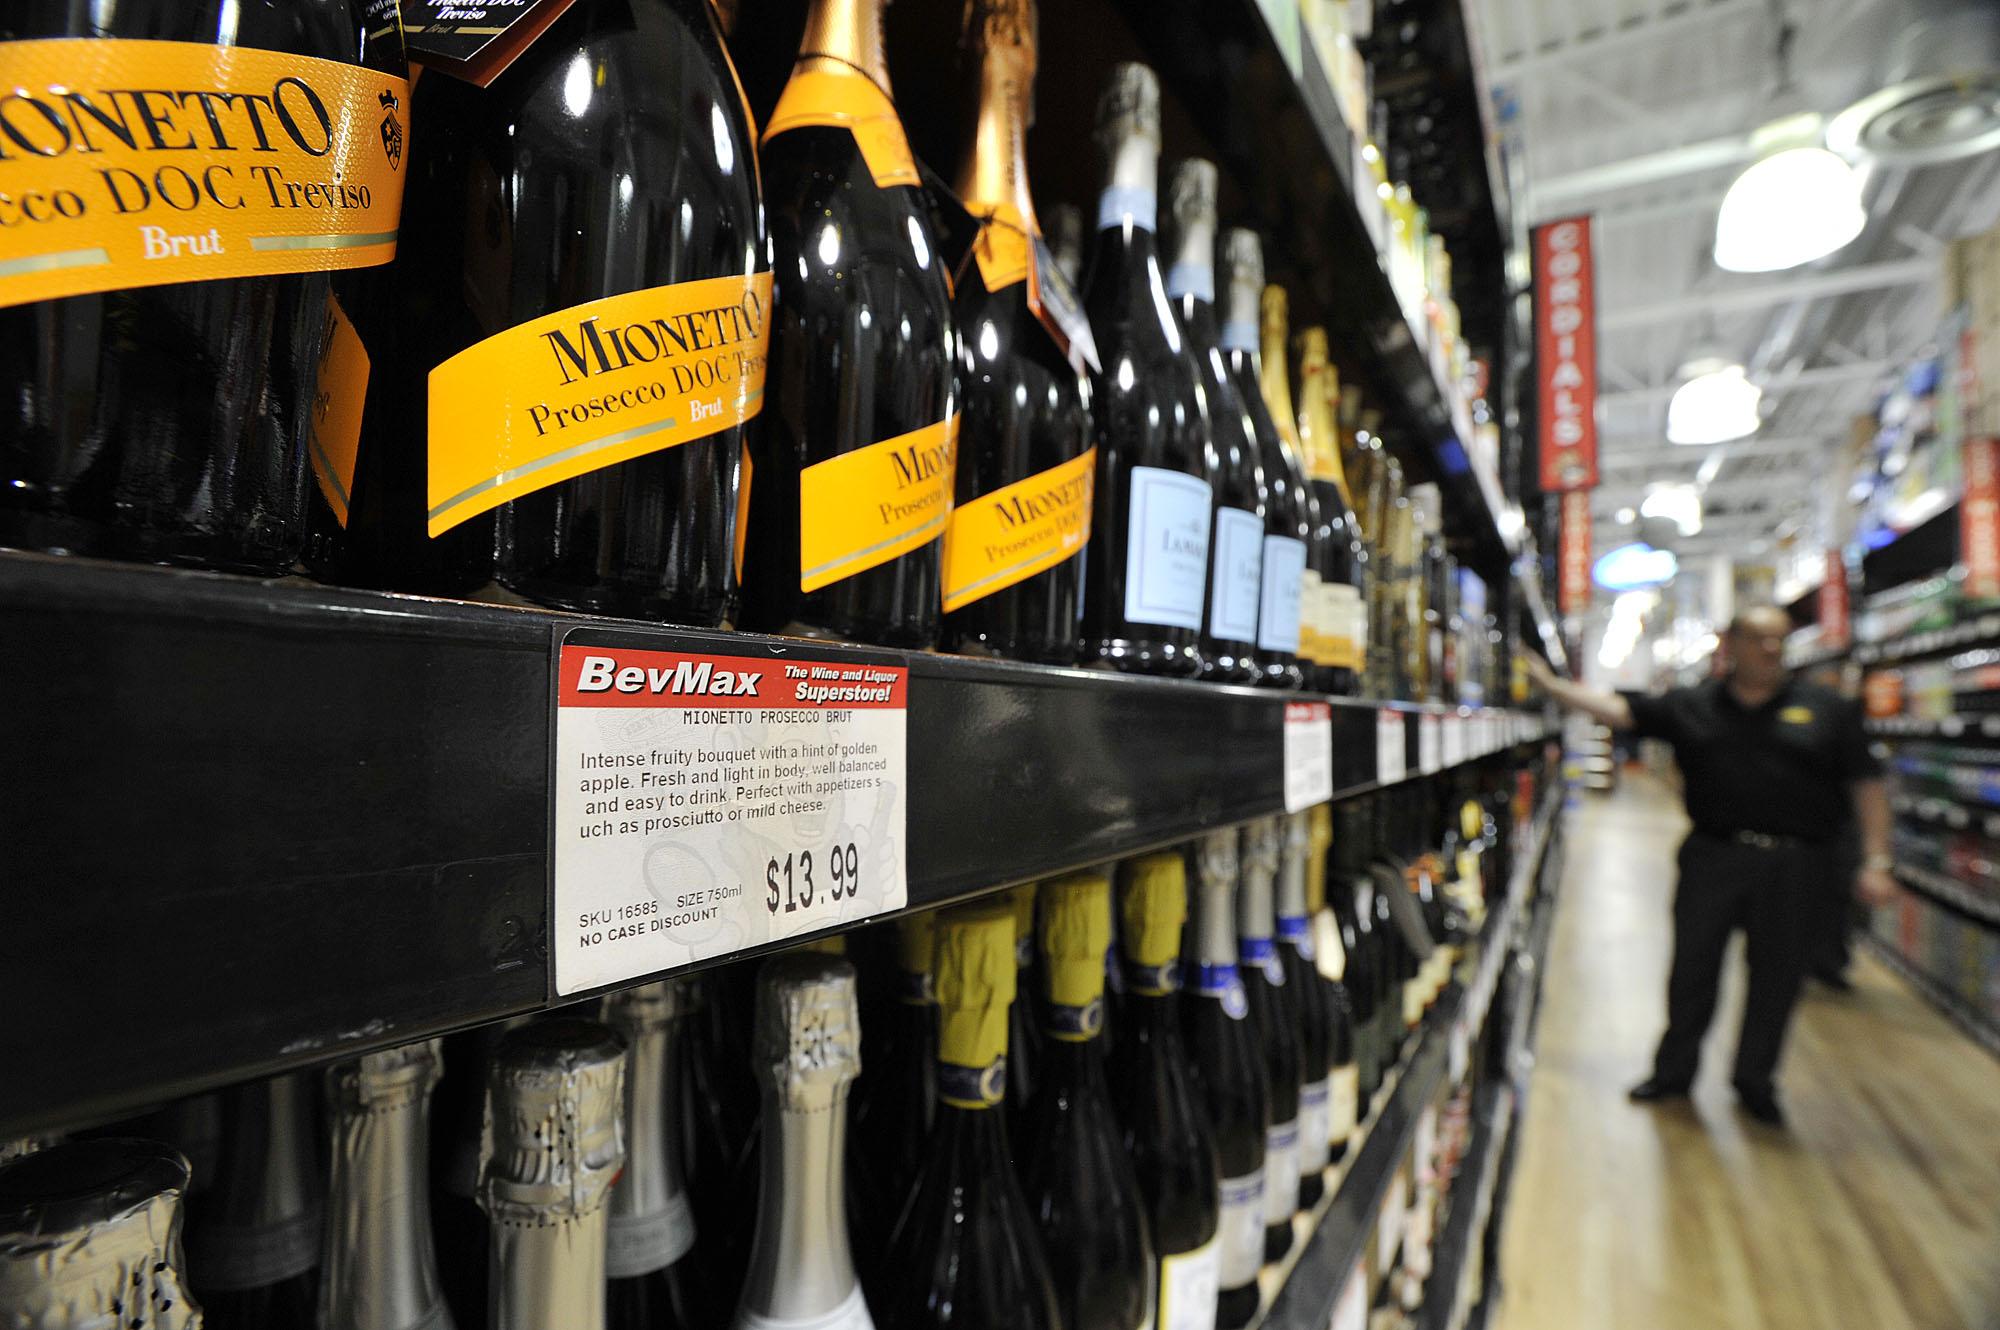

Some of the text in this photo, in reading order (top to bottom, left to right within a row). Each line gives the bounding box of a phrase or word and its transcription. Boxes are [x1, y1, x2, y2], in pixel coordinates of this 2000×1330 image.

[435, 7, 487, 20] Treviso
[0, 77, 333, 160] ONETTO
[94, 165, 246, 214] DOC
[251, 165, 371, 209] Treviso
[139, 225, 225, 260] Brut
[539, 288, 762, 386] MIONETTO
[1547, 222, 1584, 447] CORDIALS
[525, 382, 666, 437] Prosecco
[669, 353, 731, 395] DOC
[688, 397, 723, 423] Brut
[577, 656, 763, 697] BevMax
[785, 665, 898, 685] The Wine and Liquor
[795, 682, 892, 704] Superstore!
[683, 710, 852, 725] MIONETTO PROSECCO BRUT
[581, 742, 877, 769] Intense fruity bouquet with a hint of golden
[580, 759, 887, 794] apple. Fresh and light in body, well balanced
[585, 777, 881, 815] and easy to drink. Perfect with appetizers s
[580, 800, 826, 839] uch as prosciutto or mild cheese.
[766, 842, 859, 916] $13.99
[579, 884, 742, 928] SKU 16585 SIZE 750ml
[580, 907, 719, 947] NO CASE DISCOUNT
